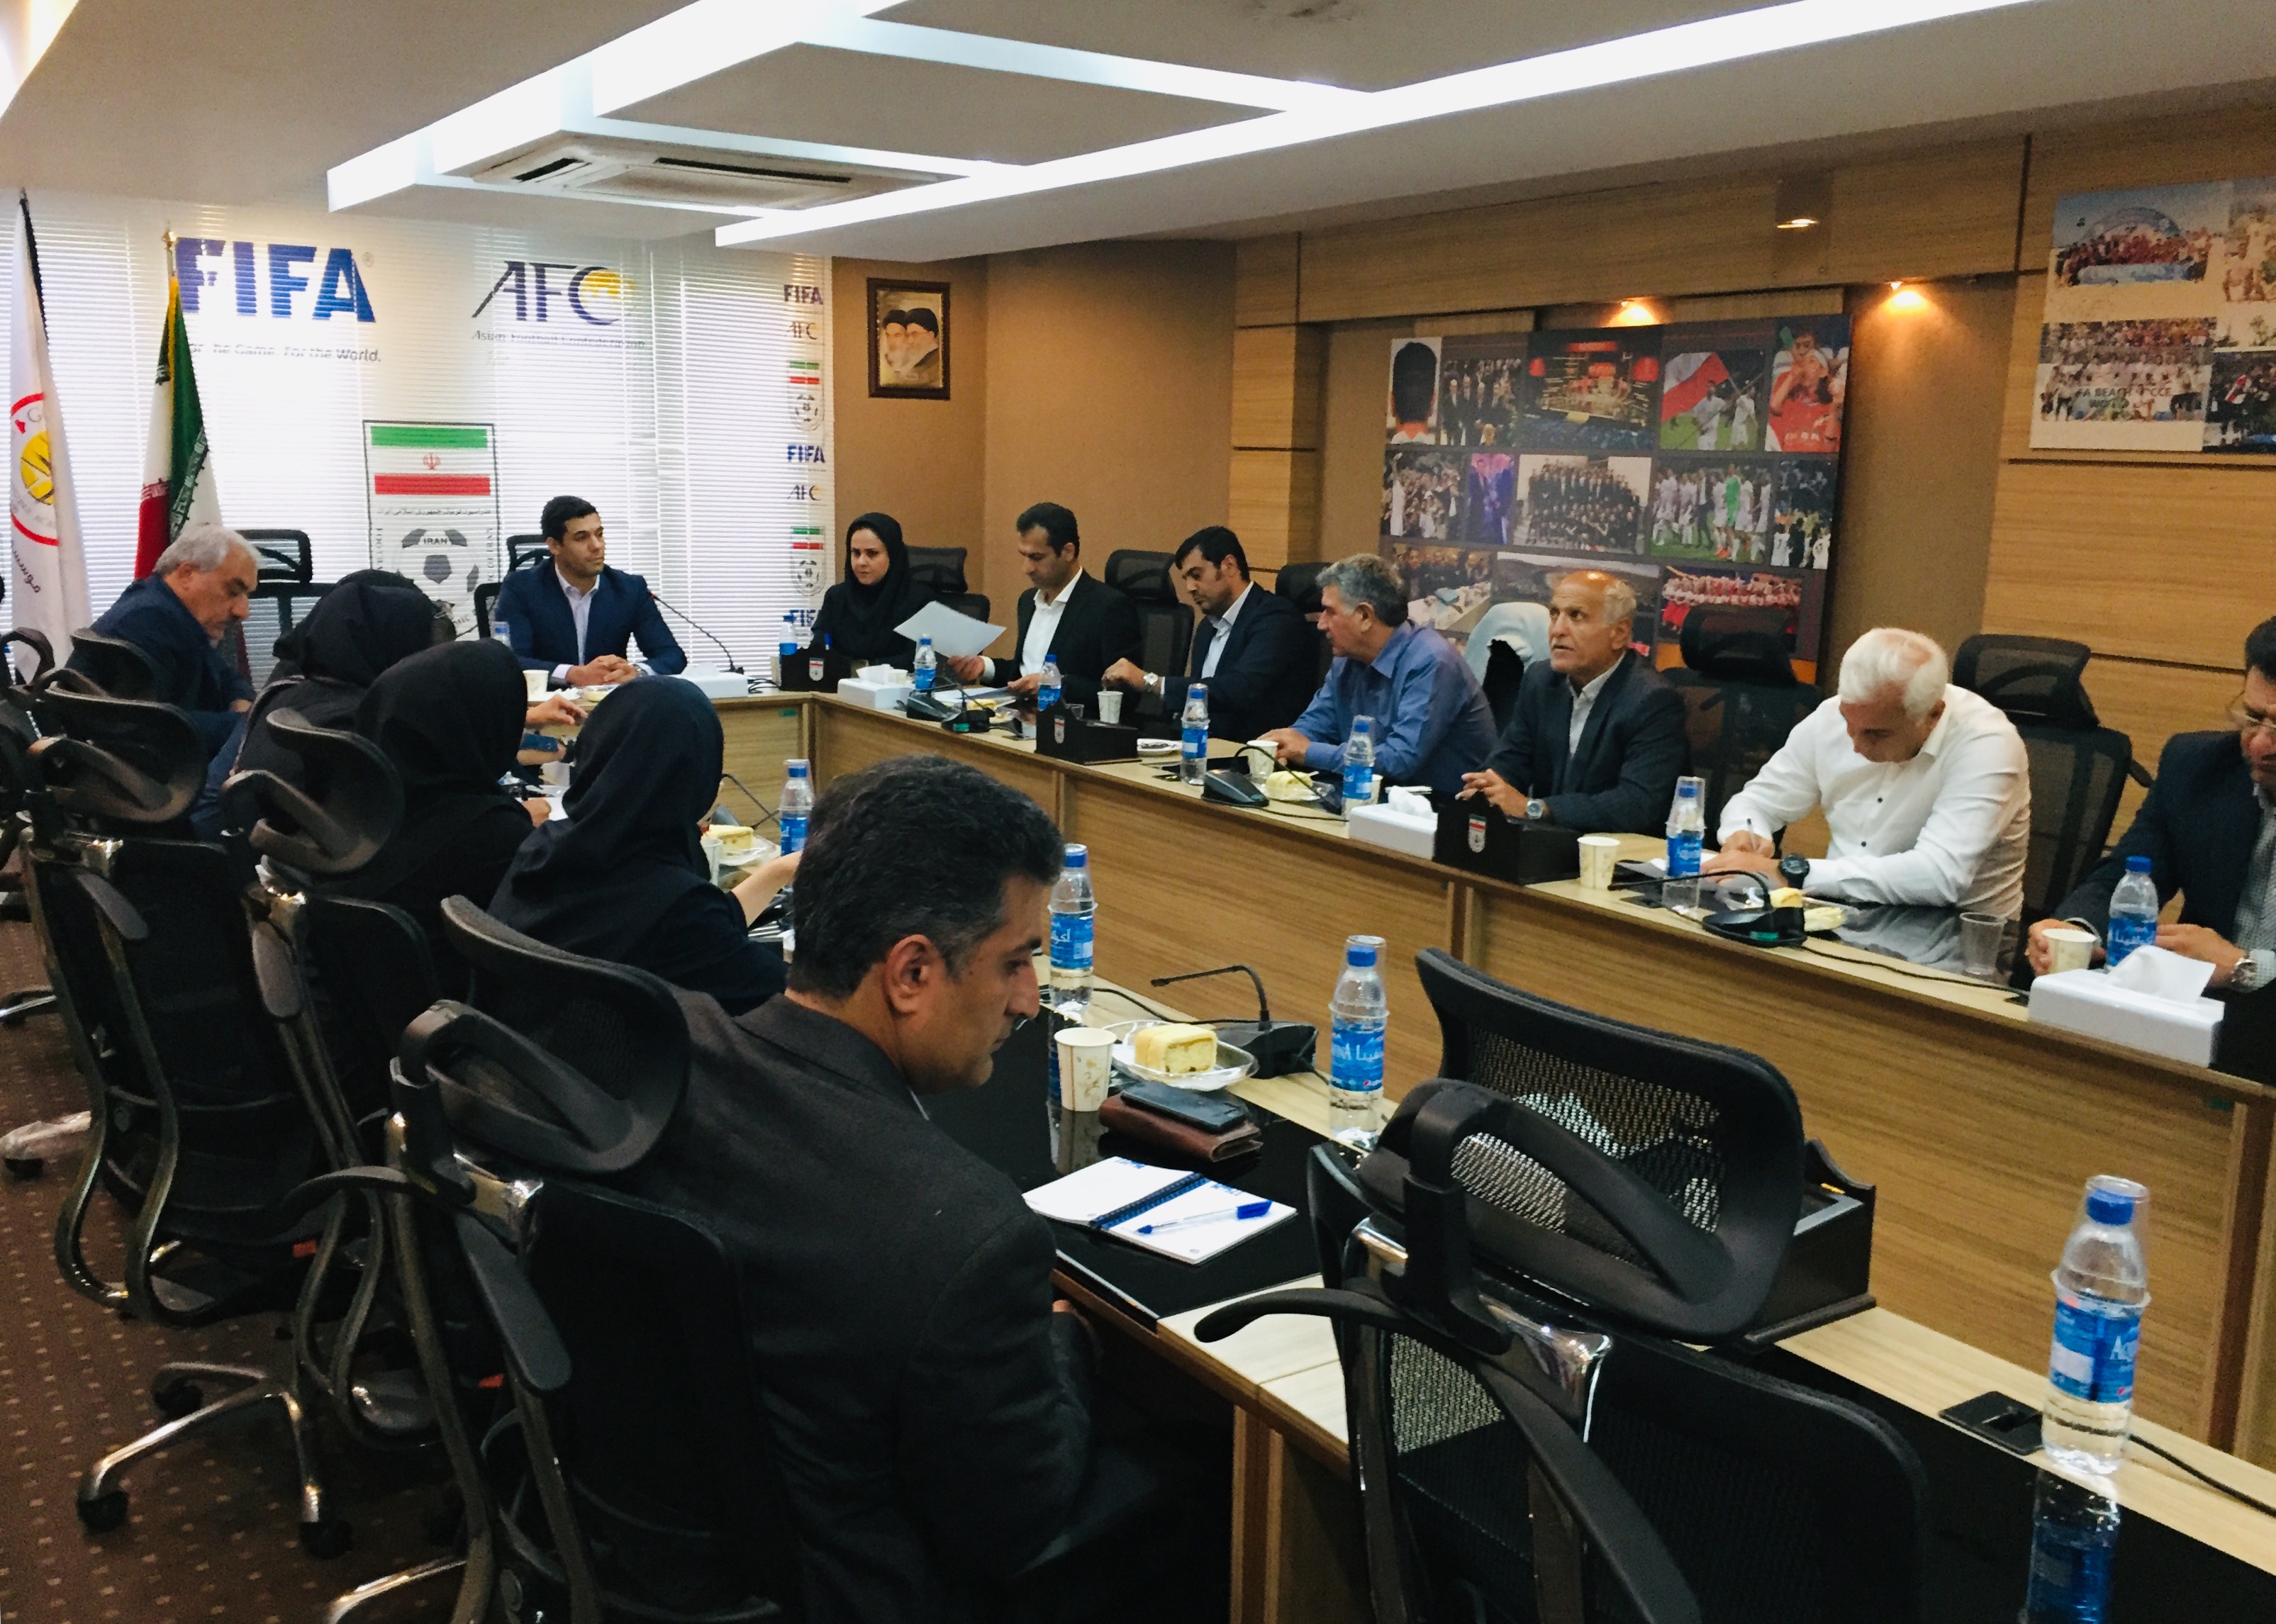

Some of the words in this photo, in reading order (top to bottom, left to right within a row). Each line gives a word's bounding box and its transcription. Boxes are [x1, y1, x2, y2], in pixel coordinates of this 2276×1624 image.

[175, 237, 376, 323] FIFA
[472, 261, 623, 325] AFC
[783, 284, 824, 305] FIFA
[335, 348, 381, 362] World.
[787, 445, 826, 464] FIFA
